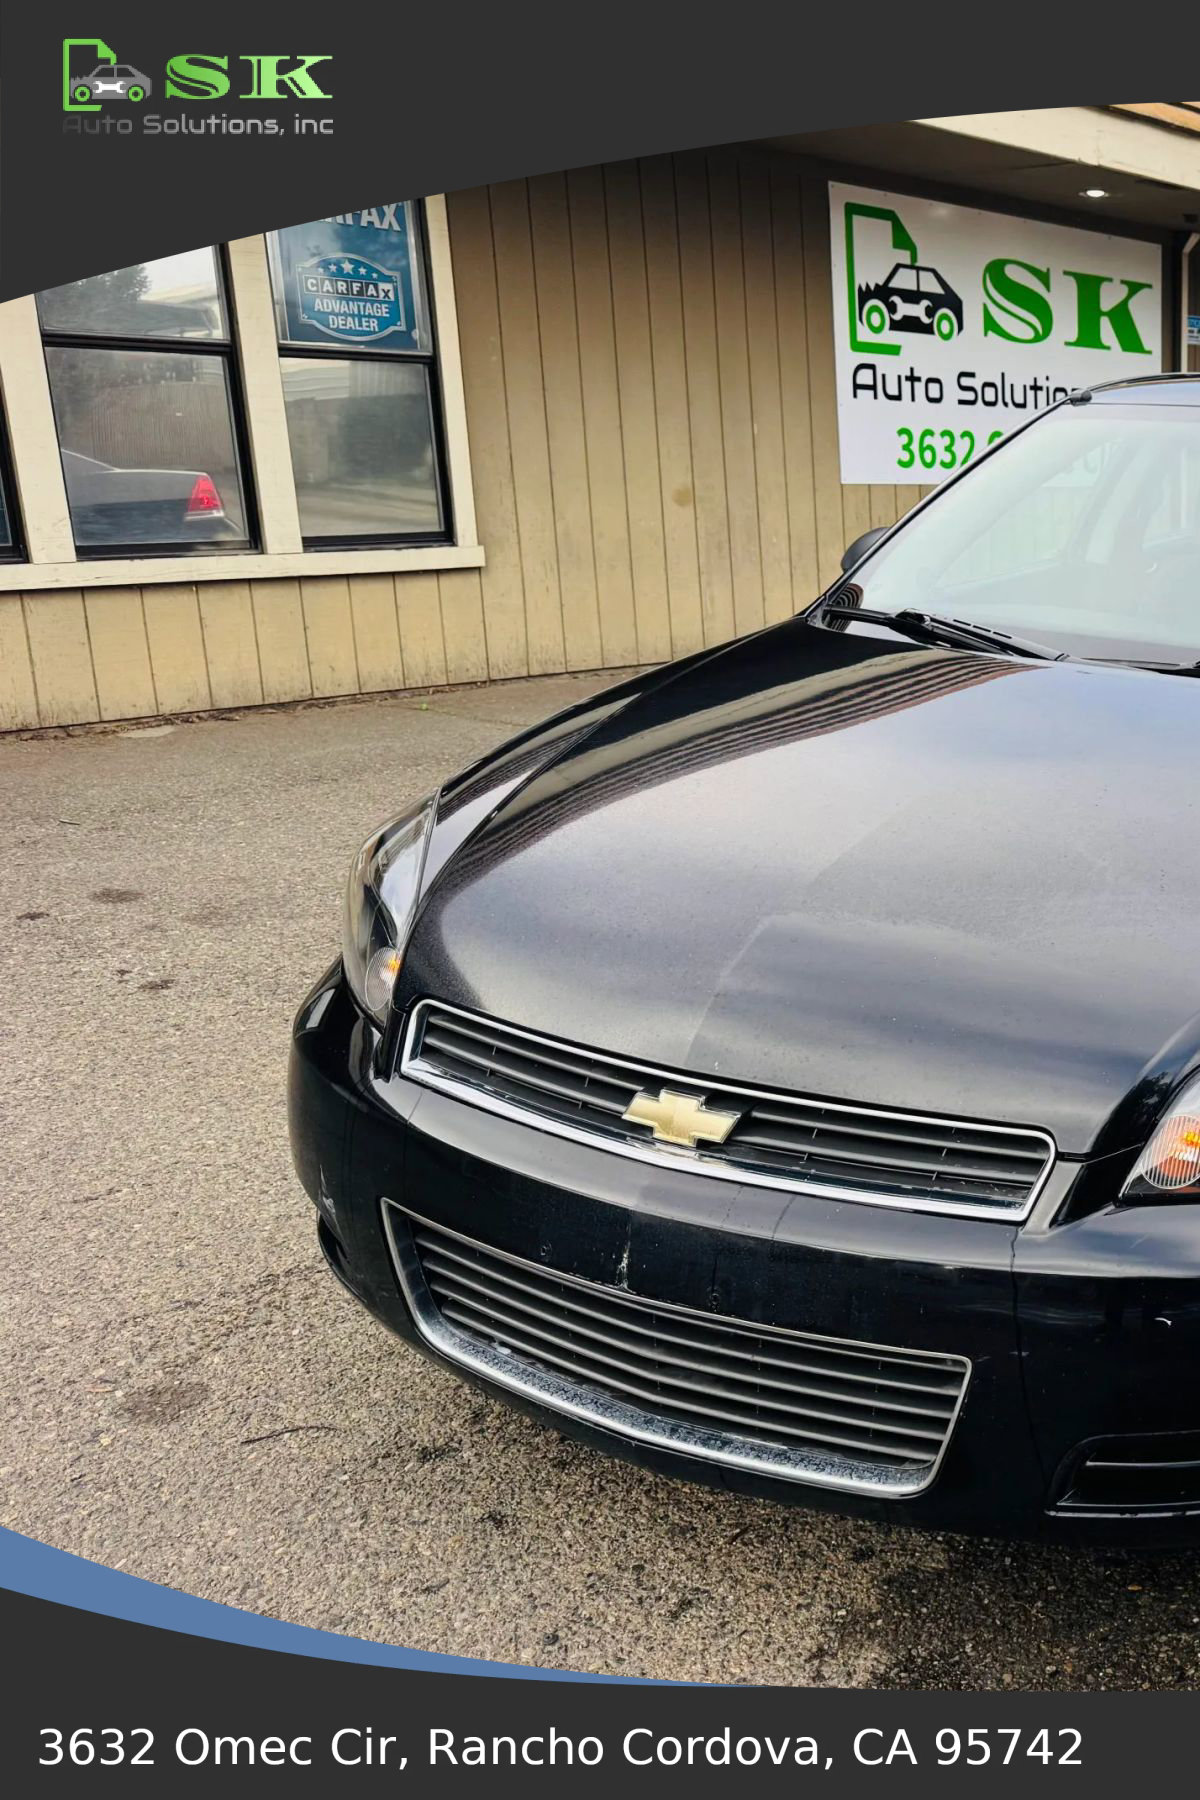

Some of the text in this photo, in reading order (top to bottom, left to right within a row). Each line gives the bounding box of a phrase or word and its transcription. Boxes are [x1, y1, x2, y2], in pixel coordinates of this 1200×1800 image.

[306, 278, 392, 299] CARFAX
[314, 299, 390, 317] ADVANTAGE
[982, 258, 1153, 355] SK
[329, 315, 379, 332] DEALER
[852, 363, 944, 404] Auto
